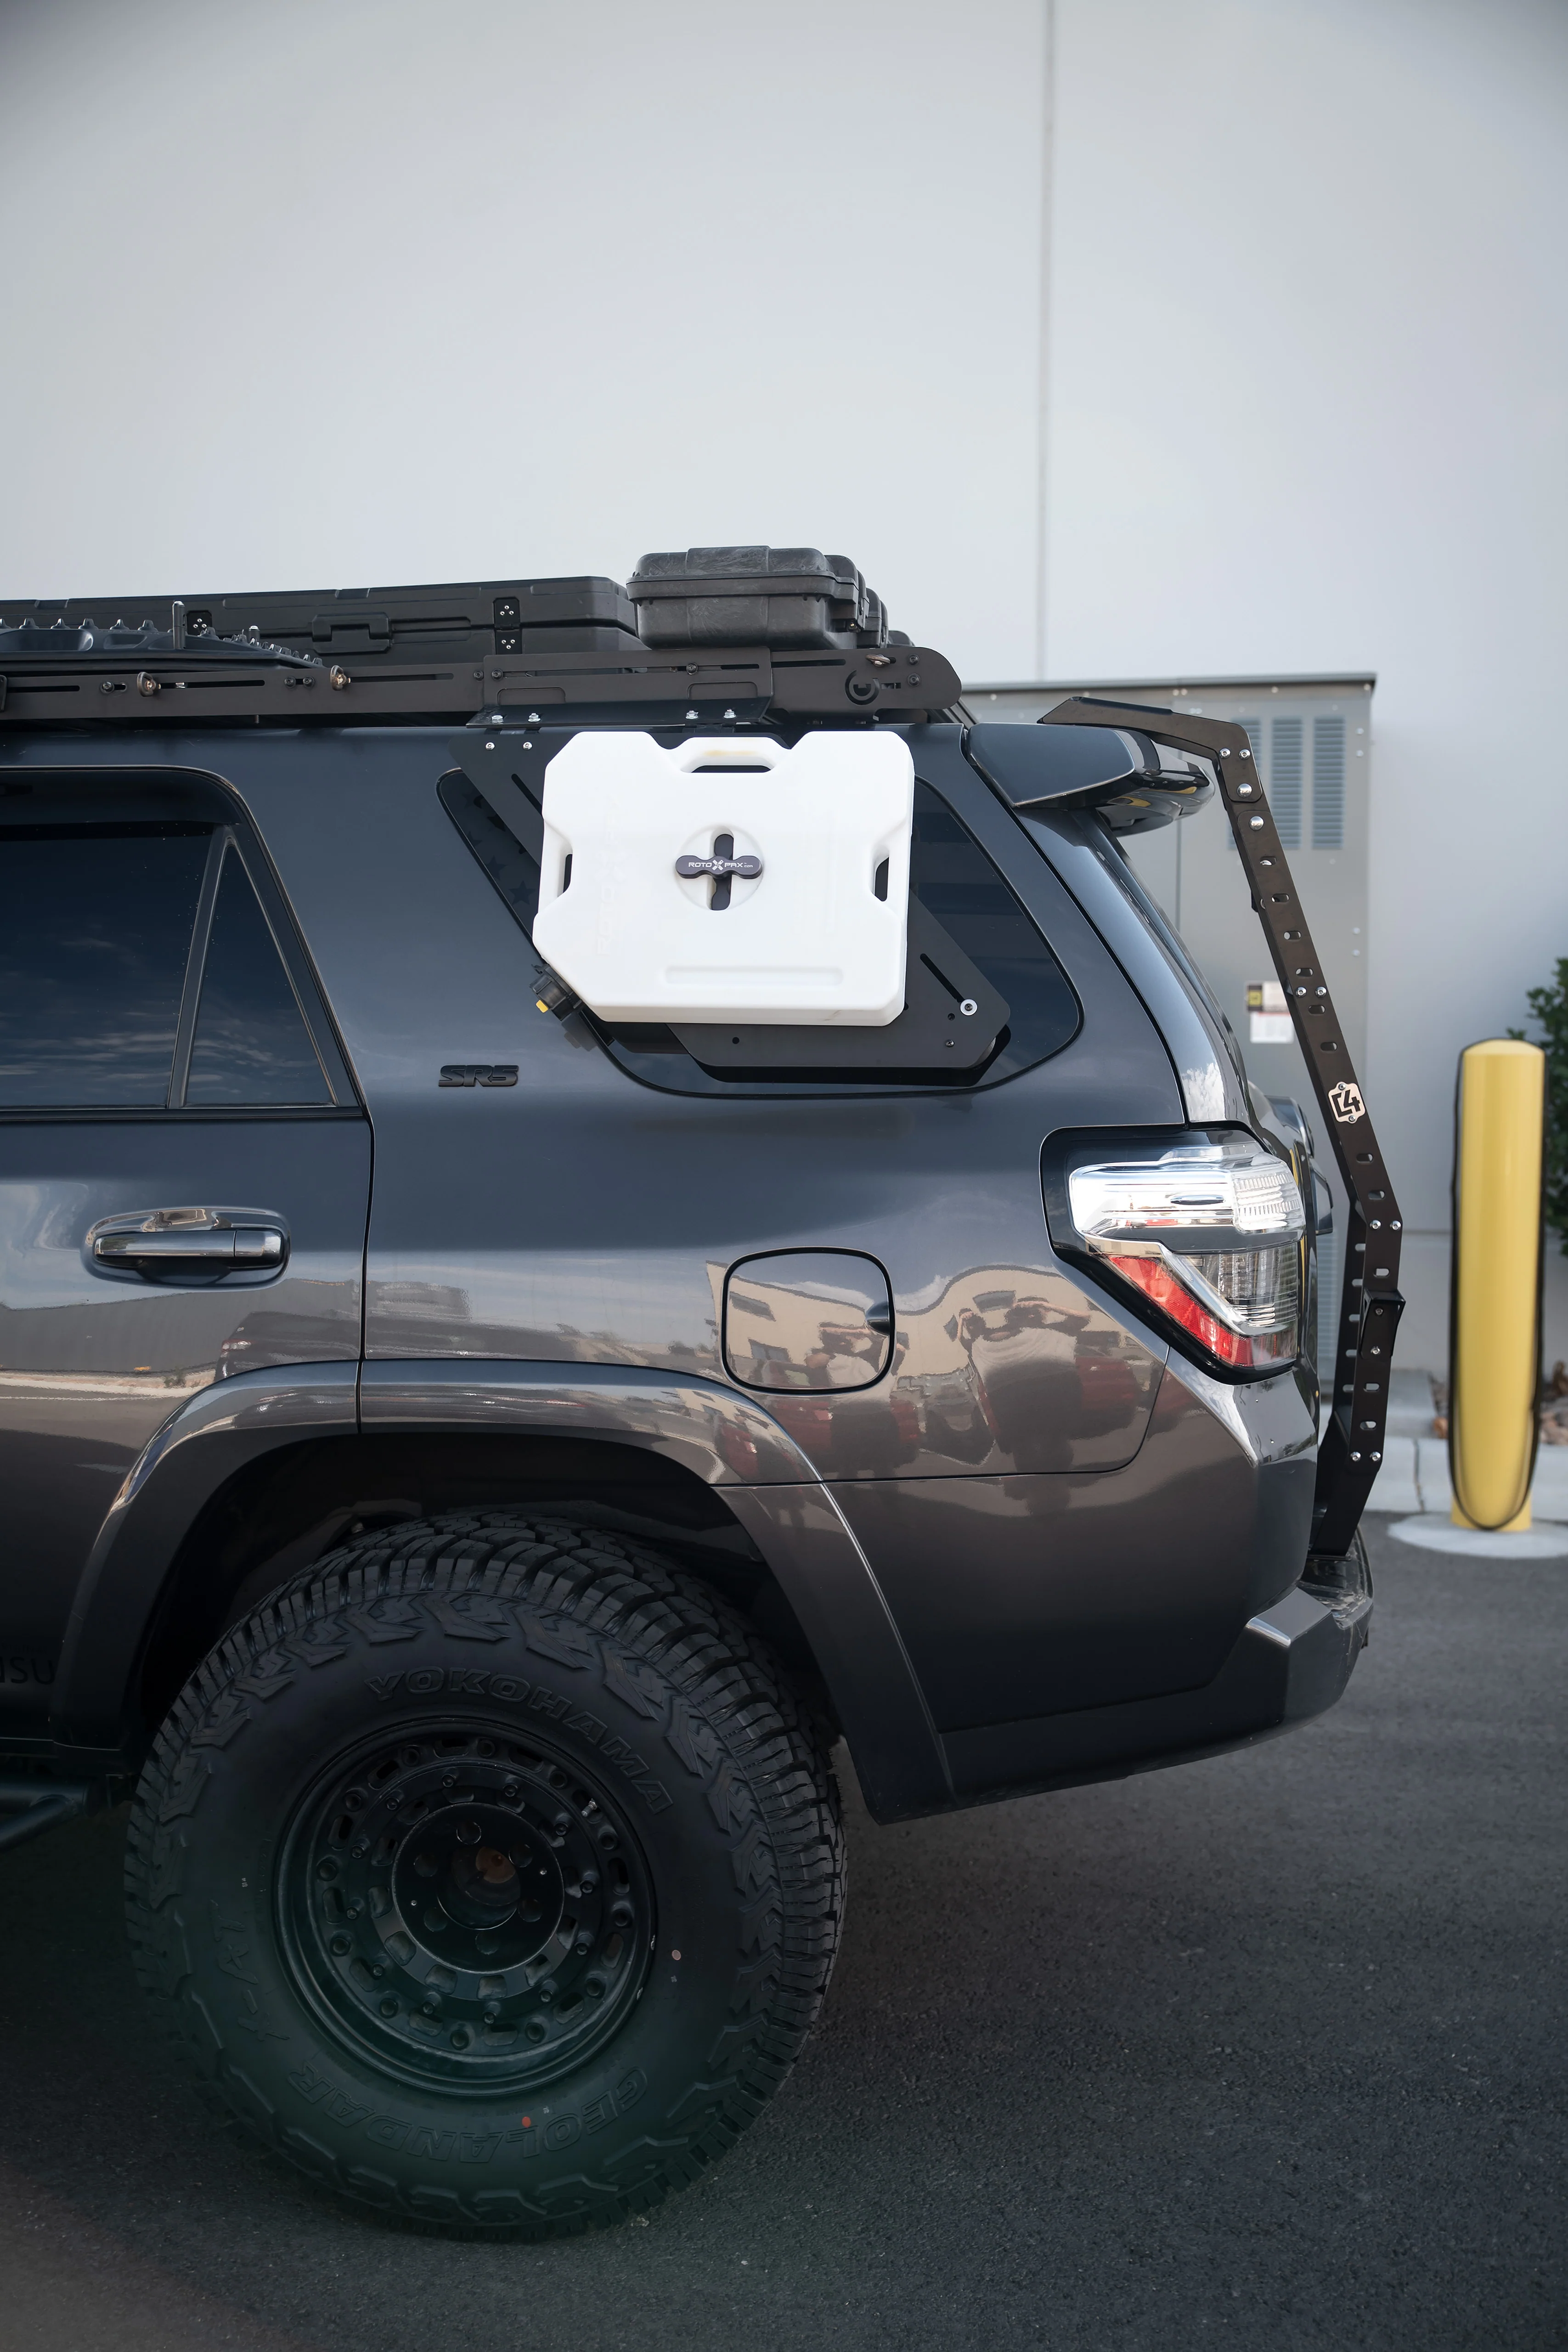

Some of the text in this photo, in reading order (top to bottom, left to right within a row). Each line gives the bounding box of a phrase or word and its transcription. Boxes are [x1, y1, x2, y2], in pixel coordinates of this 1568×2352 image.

[438, 1065, 519, 1087] SR5
[364, 1665, 674, 1815] YOKOHAMA
[287, 2058, 649, 2163] GEOLANDAR
